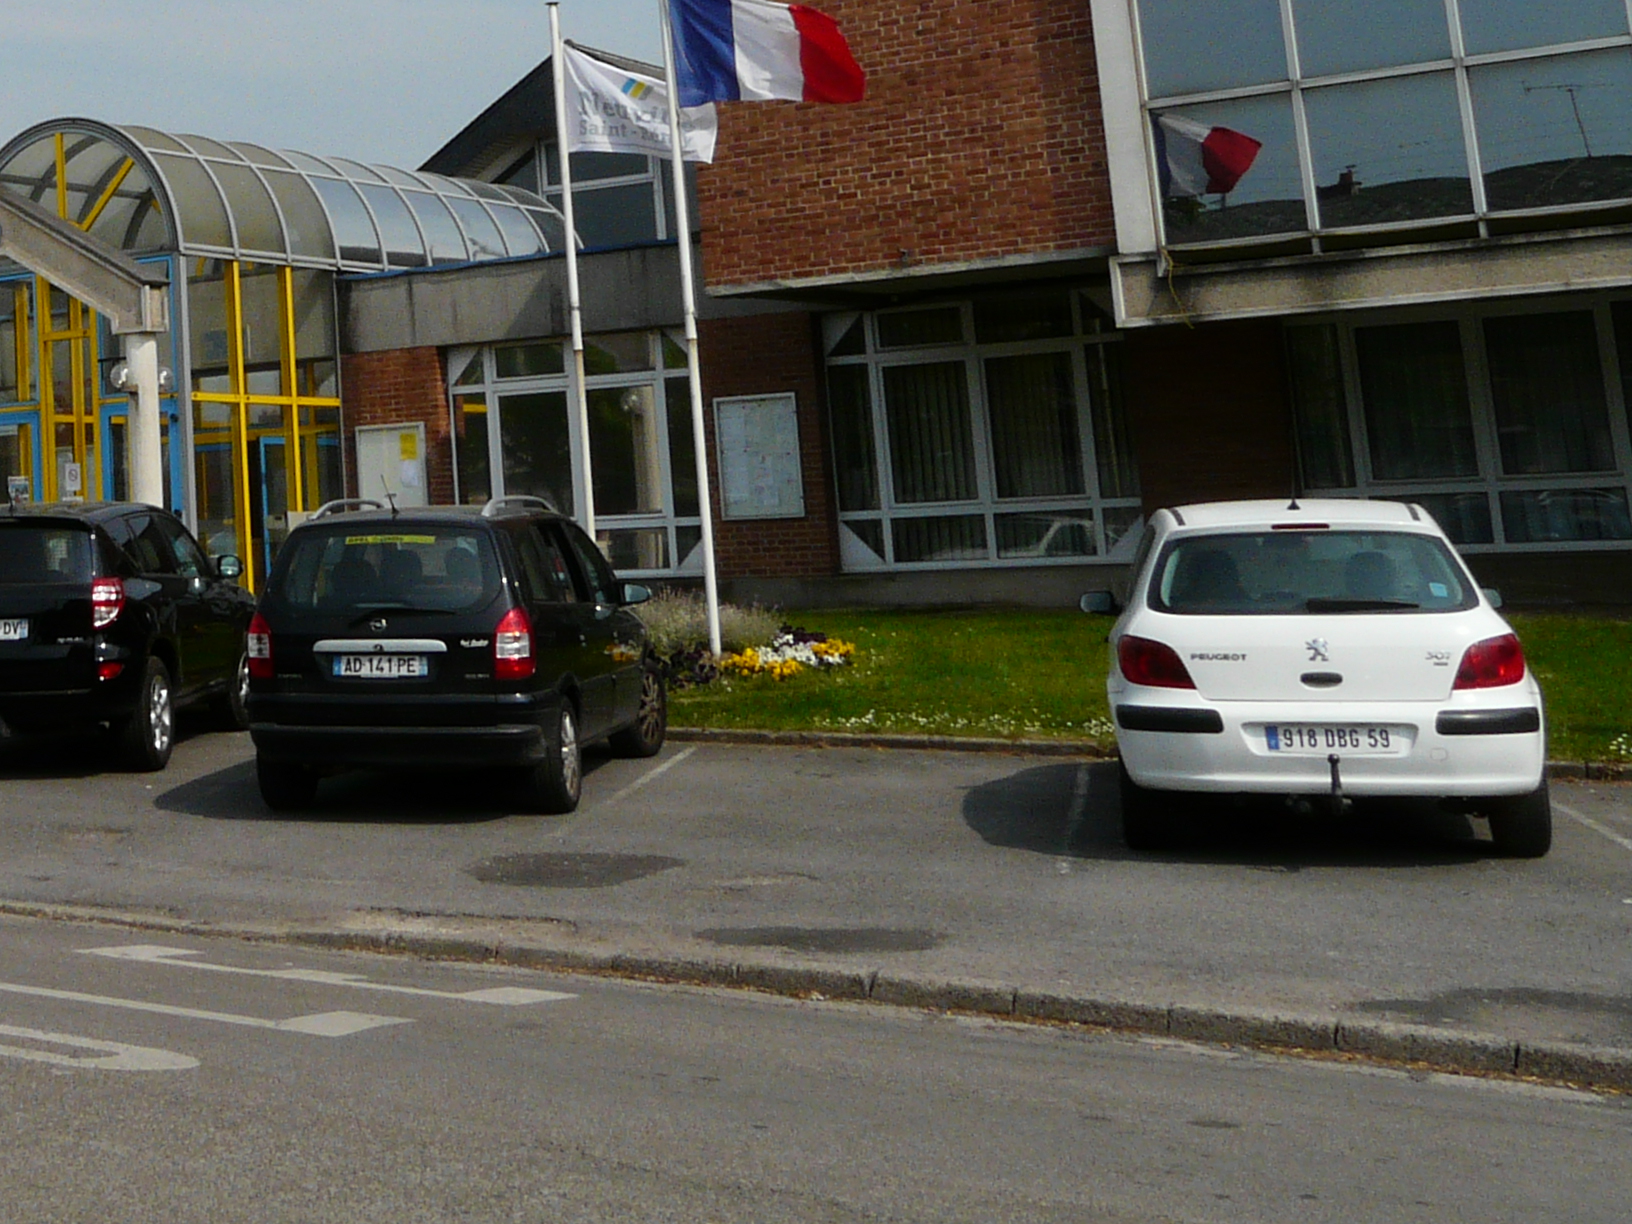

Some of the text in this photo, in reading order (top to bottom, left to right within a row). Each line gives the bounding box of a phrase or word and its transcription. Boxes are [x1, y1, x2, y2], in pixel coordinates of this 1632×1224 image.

[1190, 653, 1248, 662] PEUGEOT
[1425, 650, 1452, 661] 307
[1282, 728, 1391, 749] 918 DBG 59
